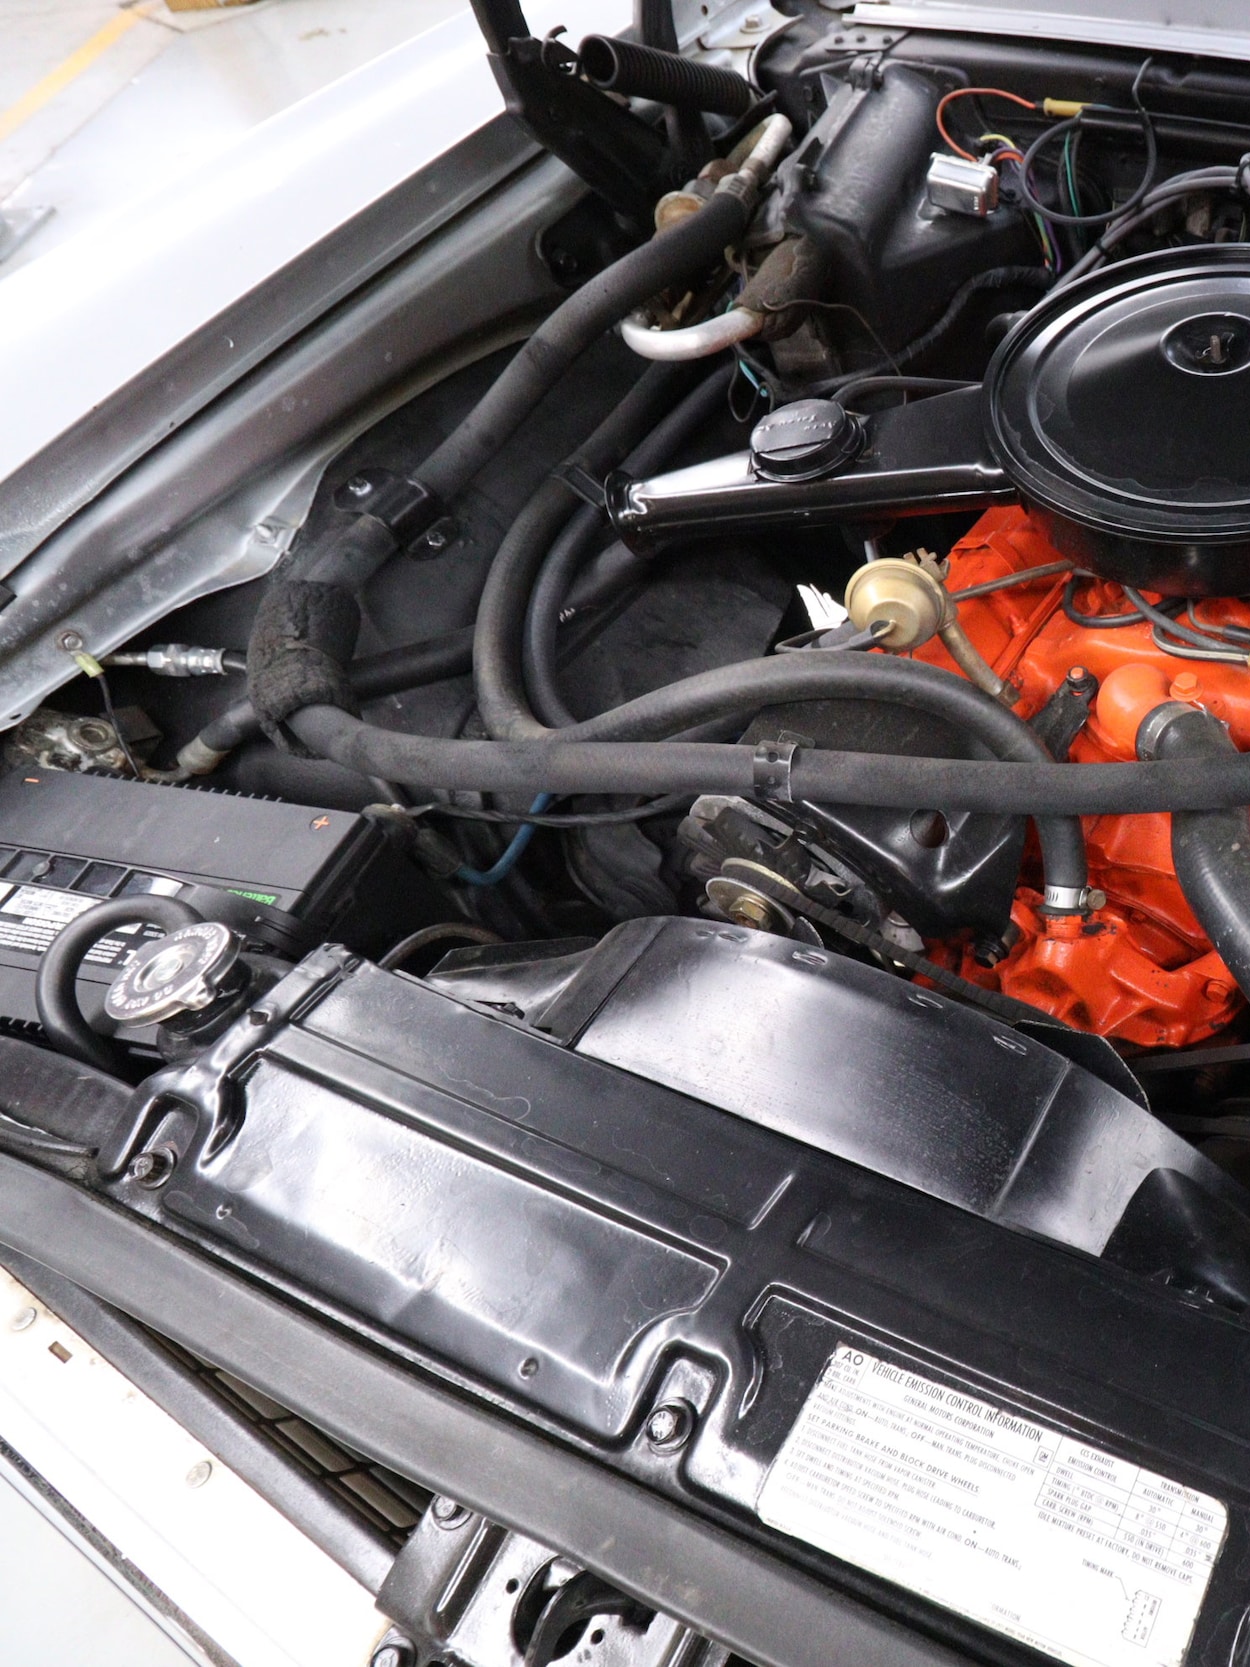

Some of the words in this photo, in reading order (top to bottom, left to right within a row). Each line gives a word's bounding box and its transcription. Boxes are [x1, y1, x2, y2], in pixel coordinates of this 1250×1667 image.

[841, 1350, 864, 1366] AO
[812, 1403, 834, 1416] VACUUM
[872, 1361, 905, 1384] VEHICLE
[904, 1376, 946, 1401] EMISSION
[945, 1393, 983, 1418] CONTROL
[984, 1410, 1043, 1442] INFORMATION
[904, 1394, 928, 1410] GENERAL
[929, 1405, 953, 1421] MOTORS
[954, 1416, 994, 1438] CORPORATION
[838, 1387, 871, 1405] ADJUSTMENTS
[872, 1402, 885, 1412] WITH
[885, 1407, 906, 1420] ENGINE
[913, 1420, 934, 1433] NORMAL
[935, 1429, 964, 1446] OPERATING
[1002, 1457, 1020, 1469] CHOKE
[1020, 1465, 1035, 1476] OPEN
[806, 1427, 837, 1444] DISCONNECT
[836, 1440, 849, 1451] FUEL
[850, 1446, 863, 1457] TANK
[863, 1453, 878, 1464] HOSE
[878, 1458, 893, 1470] FROM
[893, 1466, 911, 1478] VAPOR
[807, 1412, 821, 1423] SET
[821, 1419, 854, 1438] PARKING
[855, 1433, 880, 1449] BRAKE
[880, 1445, 899, 1457] AND
[899, 1452, 925, 1468] BLOCK
[926, 1464, 949, 1479] DRIVE
[1079, 1448, 1091, 1458] CCS
[1090, 1452, 1115, 1467] EXHAUST
[795, 1449, 806, 1459] SET
[805, 1454, 821, 1465] DWELL
[823, 1462, 834, 1471] AND
[836, 1467, 853, 1478] TIMING
[853, 1475, 863, 1483] AT
[862, 1478, 887, 1495] SPECIFIED
[801, 1438, 832, 1455] DISCONNECT
[831, 1452, 864, 1470] DISTRIBUTOR
[864, 1466, 886, 1480] VACUUM
[901, 1482, 915, 1494] PLUG
[915, 1488, 930, 1500] HOSE
[930, 1496, 953, 1510] LEADING
[953, 1504, 962, 1514] TO
[963, 1453, 978, 1465] PLUG
[978, 1460, 1016, 1481] DISCONNECTED
[1056, 1466, 1073, 1479] DWELL
[1067, 1456, 1093, 1472] EMISSION
[1093, 1467, 1117, 1483] CONTROL
[789, 1461, 810, 1474] ADJUST
[809, 1470, 841, 1488] CARBURETOR
[840, 1483, 857, 1495] SPEED
[858, 1493, 875, 1503] SCREW
[874, 1497, 883, 1508] TO
[883, 1502, 909, 1518] SPECIFIED
[908, 1513, 921, 1524] RPM
[921, 1519, 936, 1530] WITH
[936, 1525, 947, 1535] AIR
[1048, 1488, 1064, 1501] SPARK
[1065, 1495, 1079, 1507] PLUG
[1079, 1502, 1092, 1512] GAP
[1052, 1477, 1070, 1490] TIMING
[1080, 1489, 1095, 1501] BTDC
[1142, 1488, 1174, 1506] AUTOMATIC
[1161, 1481, 1200, 1503] TRANSMISSION
[846, 1499, 858, 1507] NOT
[858, 1504, 878, 1516] ADJUST
[879, 1513, 904, 1529] SOLENOID
[1059, 1506, 1076, 1518] SCREW
[1076, 1513, 1094, 1526] (RPM)
[1154, 1520, 1167, 1531] 550
[1190, 1508, 1214, 1523] MANUAL
[1037, 1511, 1051, 1523] IDLE
[1051, 1517, 1075, 1532] MIXTURE
[1076, 1527, 1096, 1540] PRESET
[1095, 1536, 1105, 1544] AT
[1104, 1540, 1129, 1555] FACTORY,
[1131, 1551, 1141, 1561] DO
[1141, 1556, 1154, 1565] NOT
[1154, 1561, 1177, 1576] REMOVE
[1123, 1531, 1136, 1544] 550
[1134, 1537, 1144, 1548] (IN
[1144, 1541, 1164, 1556] DRIVE)
[1199, 1540, 1212, 1550] 600
[1082, 1559, 1098, 1571] TIMING
[1099, 1567, 1114, 1578] MARK
[1182, 1559, 1194, 1569] 600
